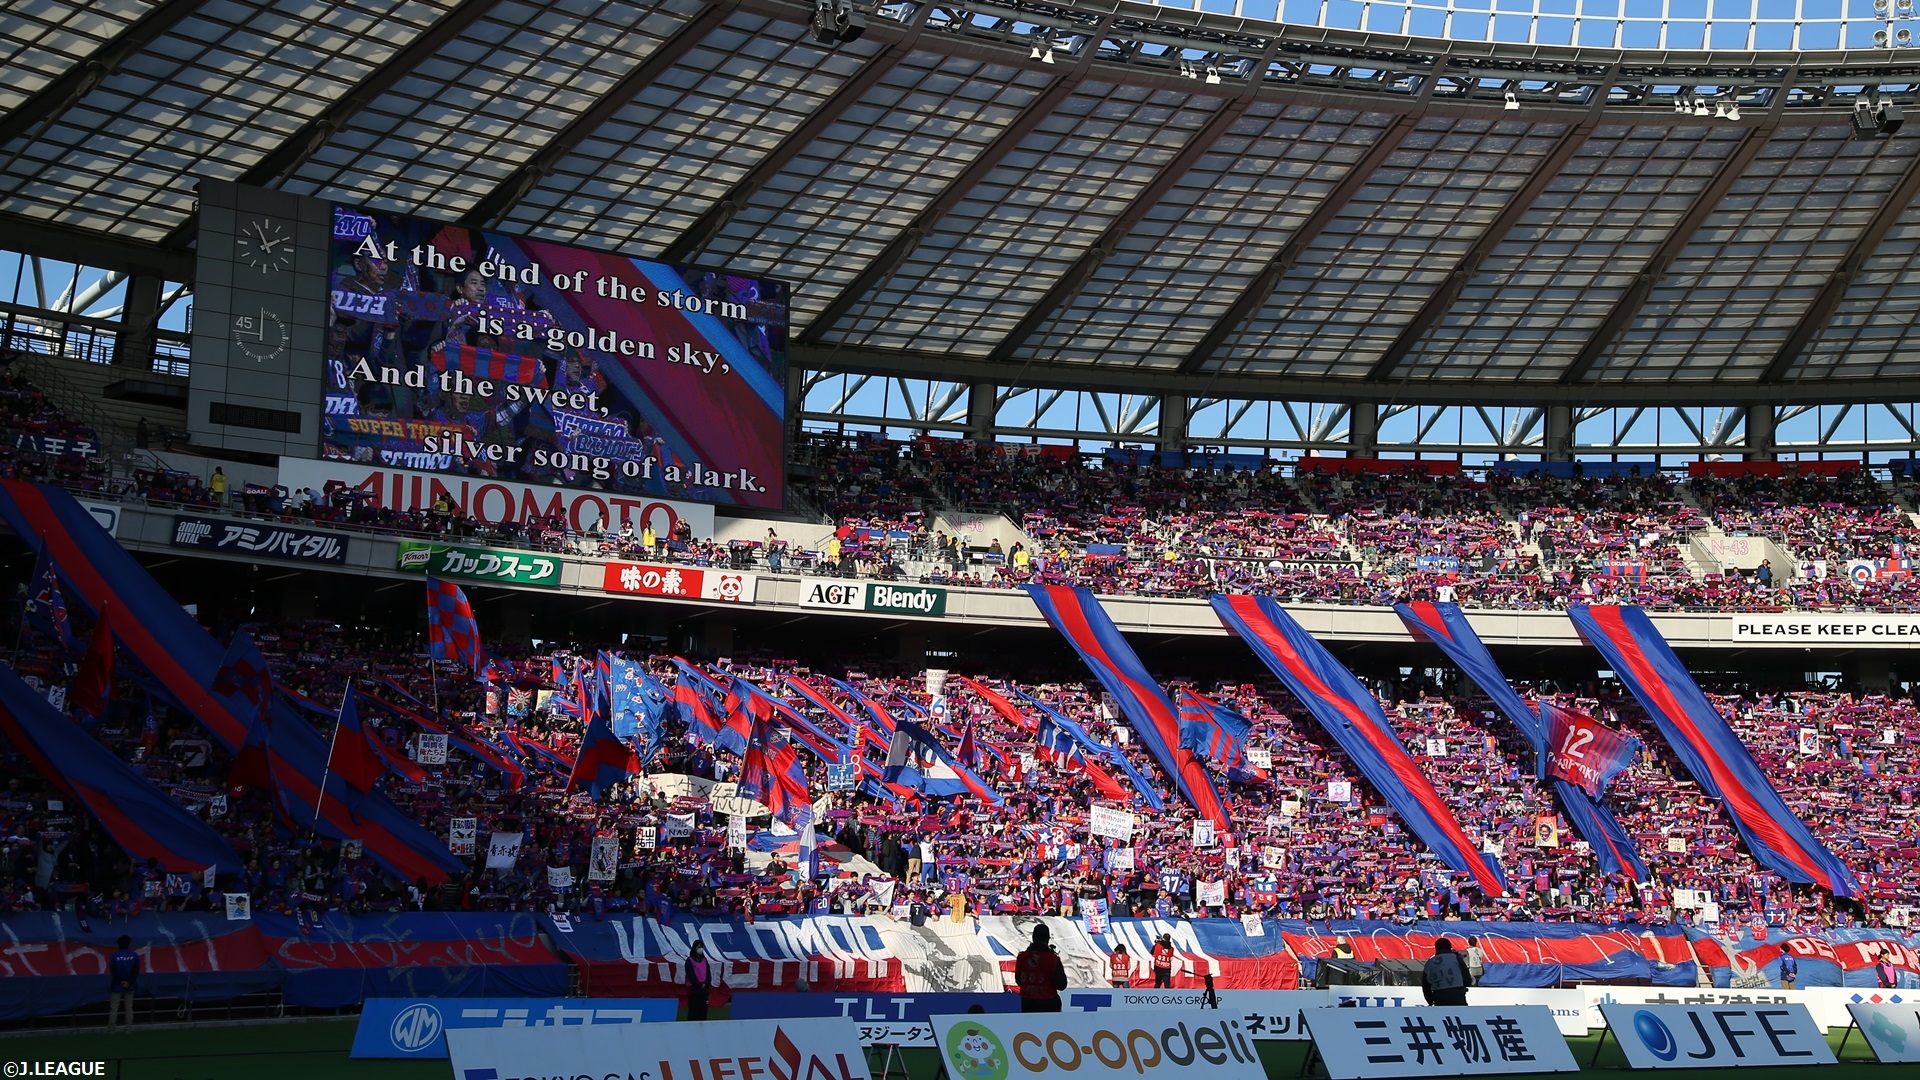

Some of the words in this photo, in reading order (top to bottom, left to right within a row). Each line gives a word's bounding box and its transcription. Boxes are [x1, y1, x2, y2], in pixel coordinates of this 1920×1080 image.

[353, 234, 398, 262] At
[411, 244, 466, 273] the
[478, 258, 541, 286] end
[553, 270, 588, 294] of
[595, 274, 647, 303] the
[657, 288, 748, 321] storm
[236, 316, 253, 330] 45
[477, 309, 504, 336] is
[516, 322, 534, 341] a
[547, 326, 656, 360] golden
[667, 342, 730, 375] sky,
[347, 356, 425, 389] And
[439, 369, 495, 398] the
[506, 384, 609, 418] sweet,
[347, 418, 405, 437] SUPER
[423, 430, 522, 464] silver
[533, 449, 611, 481] song
[622, 455, 658, 480] of
[664, 464, 682, 483] a
[692, 462, 767, 493] lark.
[178, 520, 212, 535] amino
[949, 514, 985, 532] N-46
[175, 532, 200, 545] VITAL
[217, 525, 341, 560] アミノバイタル
[1711, 539, 1749, 556] N-43
[403, 549, 430, 565] Knorr
[446, 550, 553, 580] カップスープ
[621, 565, 683, 594] 味の素
[808, 584, 859, 605] AGF
[873, 586, 937, 613] Blendy
[1738, 624, 1811, 636] PLEASE
[1817, 624, 1867, 636] KEEP
[1560, 725, 1594, 758] 12
[1162, 876, 1180, 893] 37
[817, 899, 828, 909] 20
[1766, 913, 1787, 924] ナオ
[1124, 995, 1160, 1006] TOKYO
[1162, 995, 1184, 1006] GAS
[1353, 1015, 1537, 1066] 三井物産
[1686, 1010, 1814, 1060] JFE
